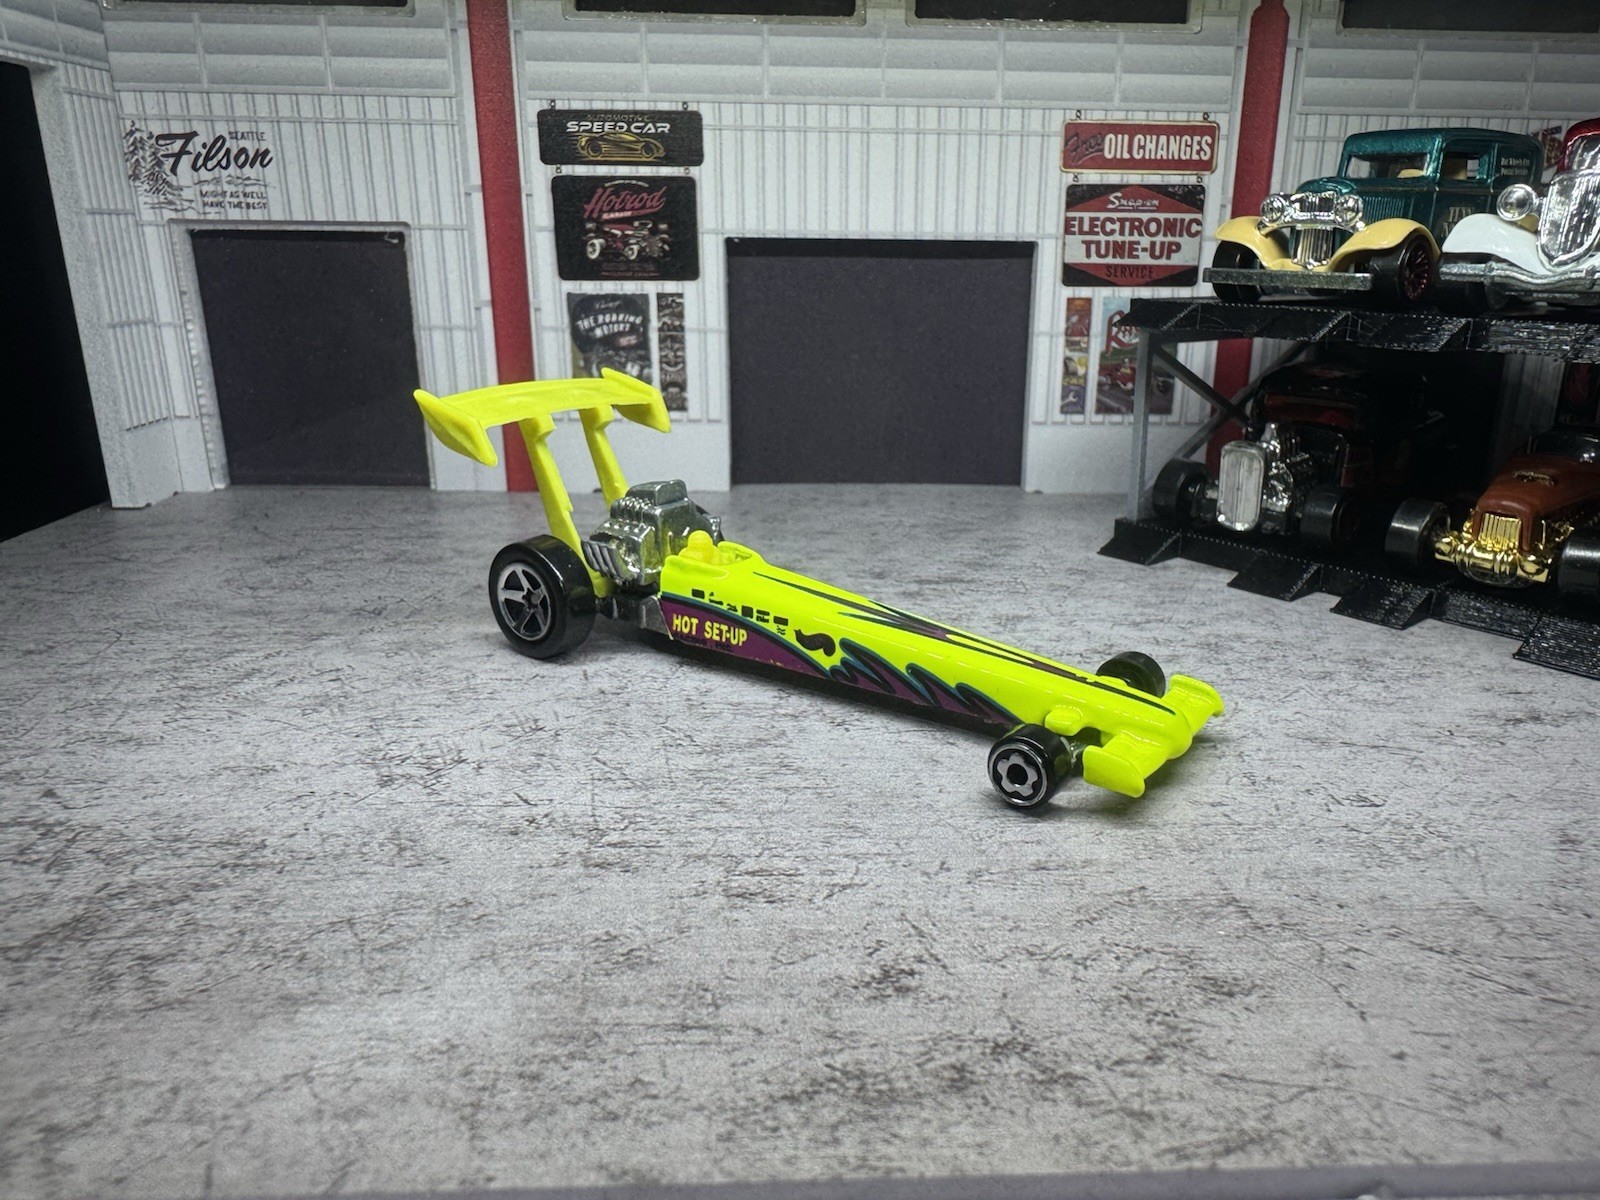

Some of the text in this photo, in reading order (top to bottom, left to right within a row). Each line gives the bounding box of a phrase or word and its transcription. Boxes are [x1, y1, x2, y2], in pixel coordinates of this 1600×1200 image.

[566, 121, 671, 133] SPEED CAR
[229, 131, 266, 142] SEATTLE
[155, 131, 273, 176] Filson
[1103, 133, 1131, 160] OIL
[1133, 134, 1212, 161] CHANGES
[242, 190, 267, 199] WELL
[582, 186, 668, 219] Hotrod
[202, 199, 268, 210] HAVE THE BEST
[1065, 216, 1202, 238] ELECTRONIC
[1081, 240, 1182, 260] TUNE-UP
[1105, 265, 1155, 279] SERVICE
[575, 315, 595, 332] THE
[672, 614, 699, 635] HOT
[704, 621, 748, 647] SET-UP
